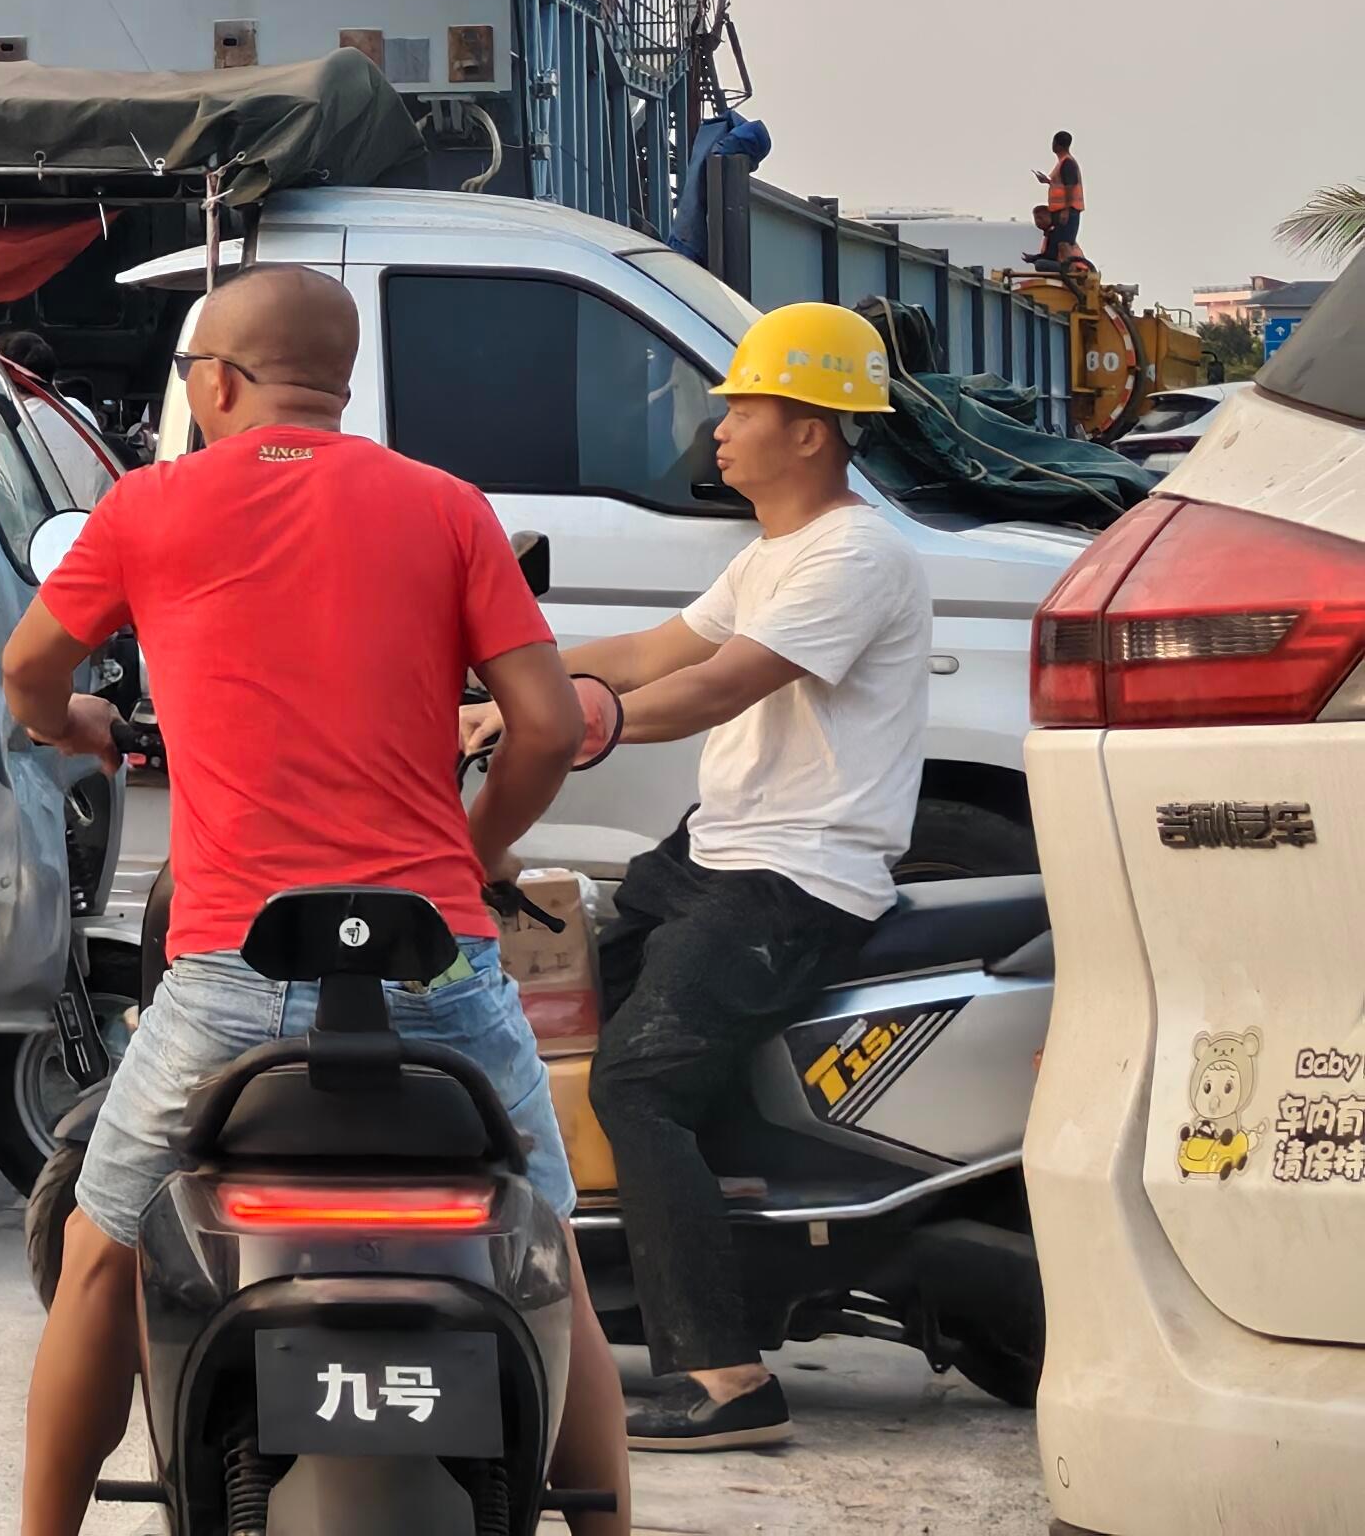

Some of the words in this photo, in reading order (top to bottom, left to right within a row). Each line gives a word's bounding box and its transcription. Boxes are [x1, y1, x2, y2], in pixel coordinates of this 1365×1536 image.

[1295, 1047, 1361, 1083] Baby
[1275, 1092, 1365, 1138] 车内有
[1273, 1138, 1365, 1182] 请保持
[316, 1363, 441, 1422] 九号
